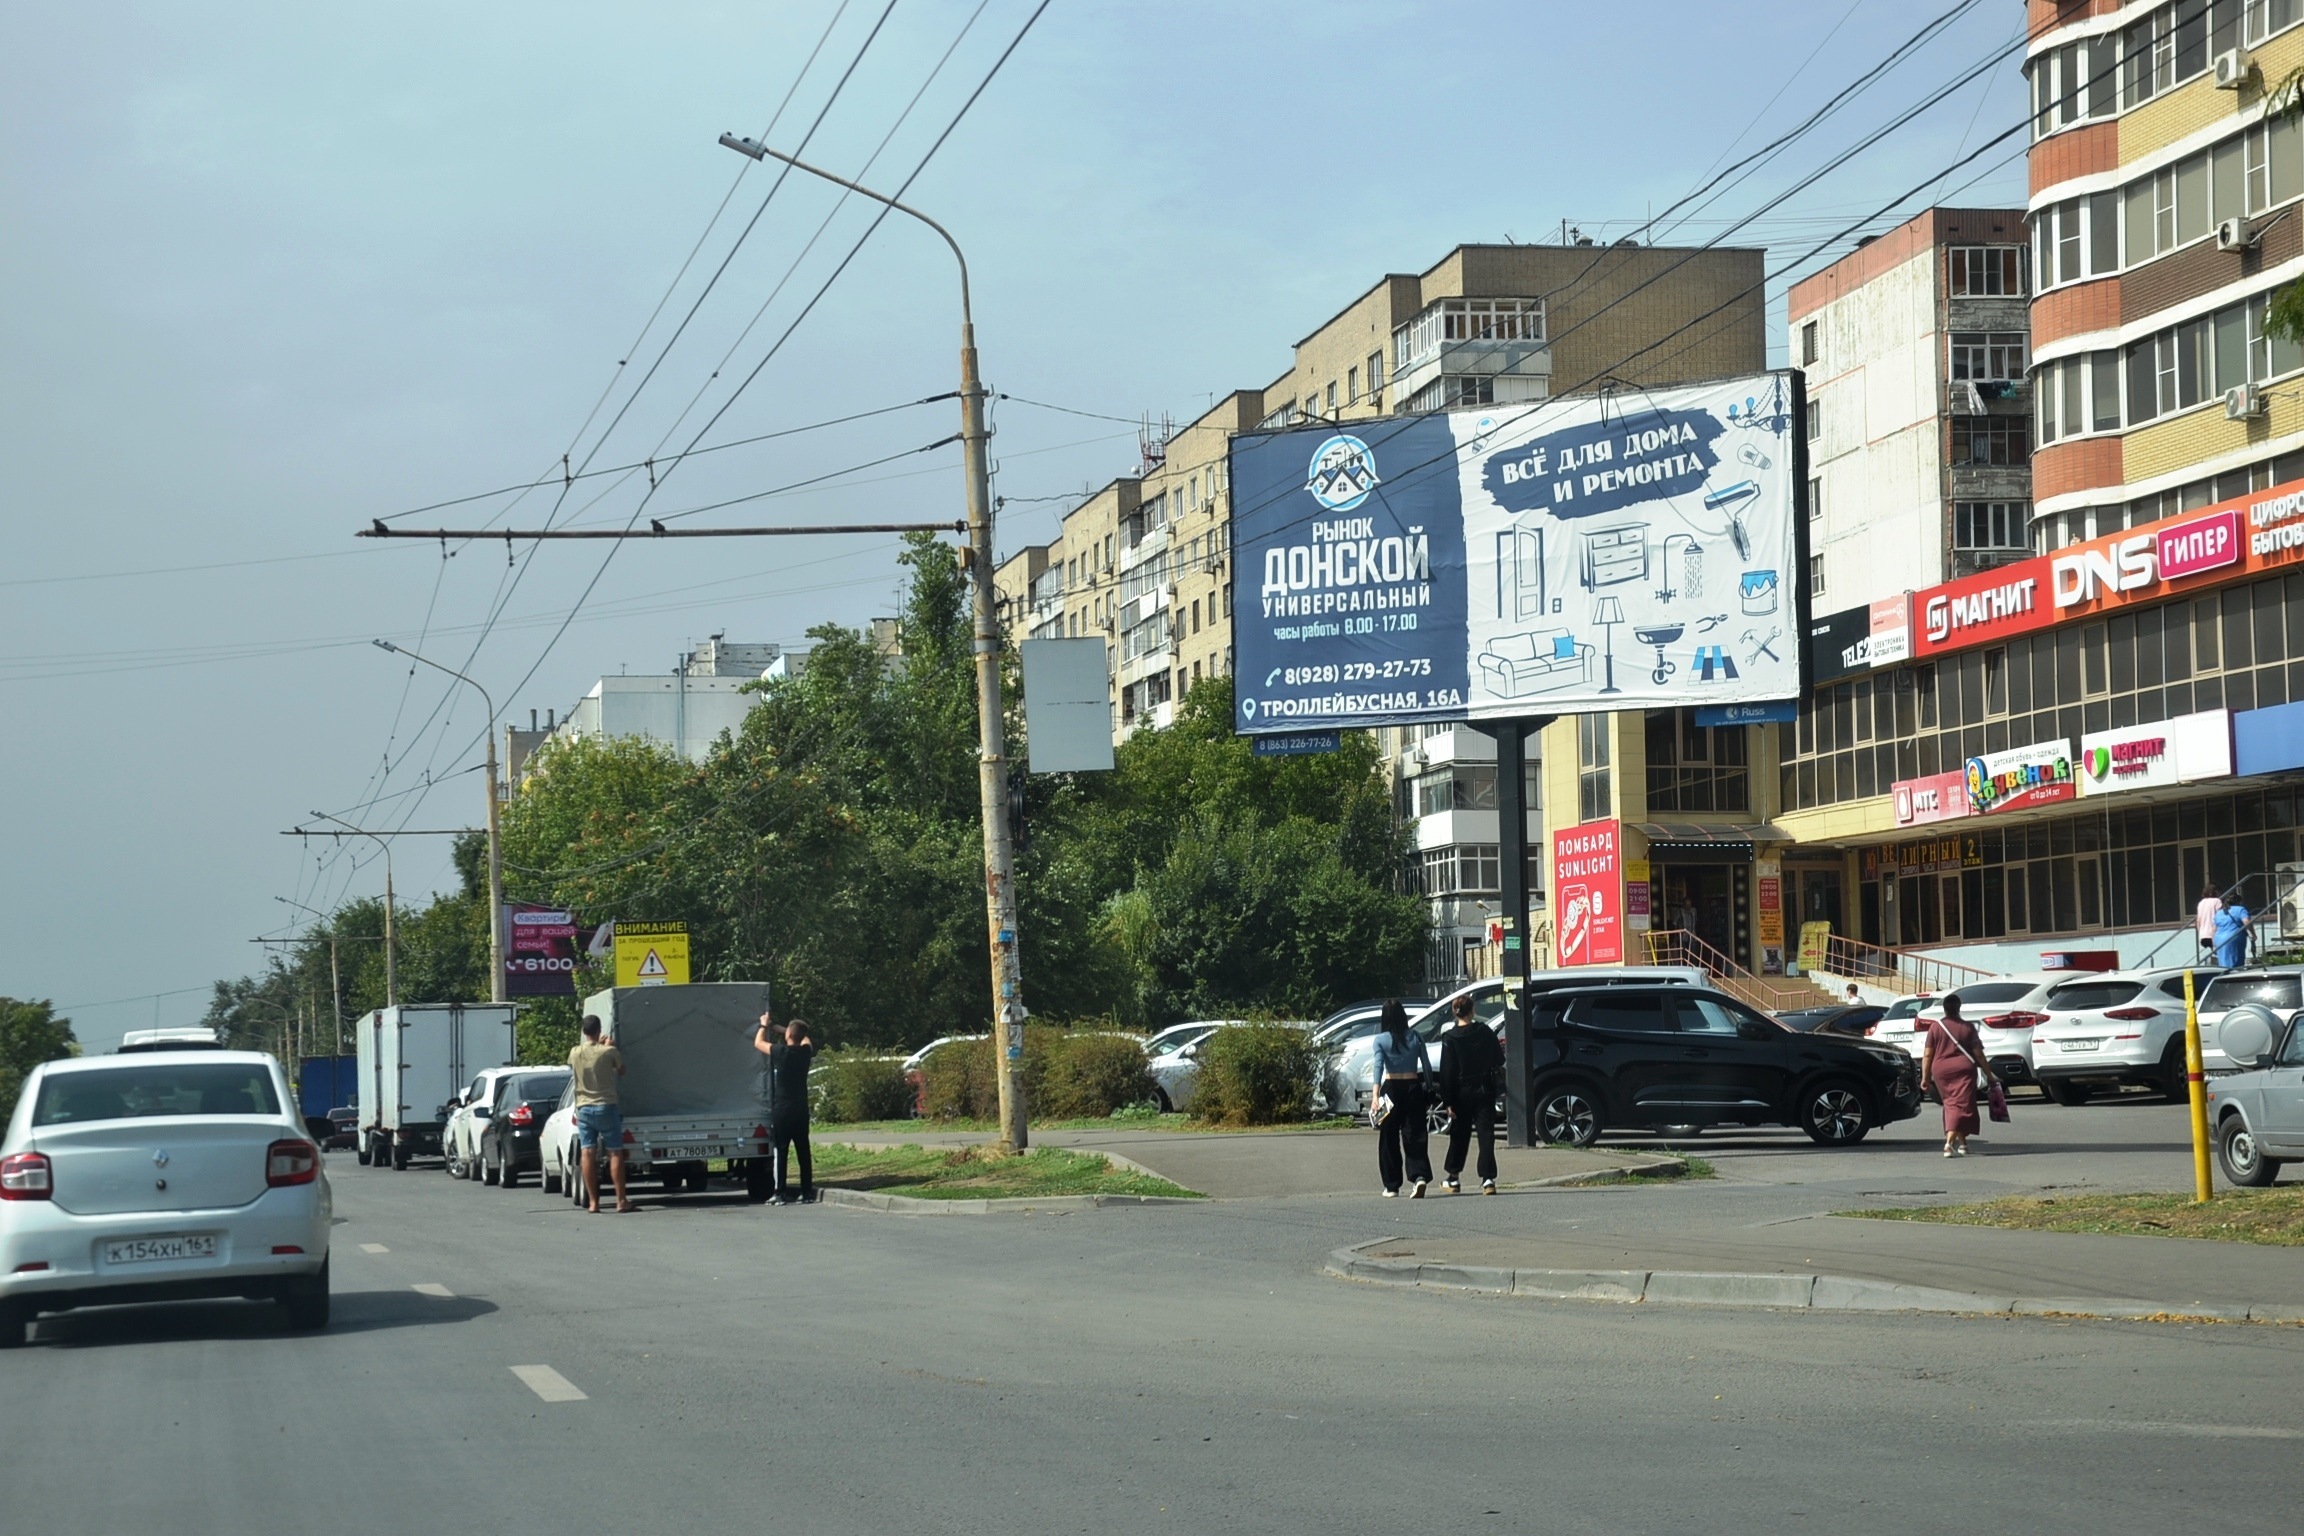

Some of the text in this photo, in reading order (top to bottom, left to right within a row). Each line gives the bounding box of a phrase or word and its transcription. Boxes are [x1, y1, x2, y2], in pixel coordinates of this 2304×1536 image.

[1502, 421, 1698, 484] ВСЁ ДЛЯ ДОМА
[1553, 452, 1704, 503] И РЕМОНТА
[1312, 517, 1373, 543] РЫНОК
[2164, 525, 2228, 567] ГИПЕР
[1262, 525, 1429, 597] ДОНСКОЙ
[2052, 533, 2156, 609] DNS
[1262, 582, 1430, 618] УНИВЕРСАЛЬНЫЙ
[1952, 578, 2037, 629] МАГНИТ
[1274, 628, 1300, 640] часы
[1302, 621, 1339, 641] работы
[1345, 617, 1373, 634] 8.00
[1382, 613, 1417, 631] 17.00
[1842, 636, 1871, 668] TELE2
[1285, 659, 1431, 686] 8(928) 279-27-73
[1261, 689, 1461, 718] ТРОЛЛЕЙБУСНАЯ, 16А
[1742, 707, 1765, 717] Russ
[1290, 737, 1332, 750] 226-77-26
[1913, 789, 1938, 814] МТС
[1558, 832, 1613, 857] ЛОМБАРД
[1968, 839, 1976, 857] 2
[1559, 855, 1613, 879] SUNLIGHT
[517, 913, 569, 924] Квартиры
[615, 920, 687, 934] ВНИМАНИЕ!
[516, 926, 575, 938] для вашей
[516, 939, 550, 949] семьи!
[187, 1238, 214, 1251] 161
